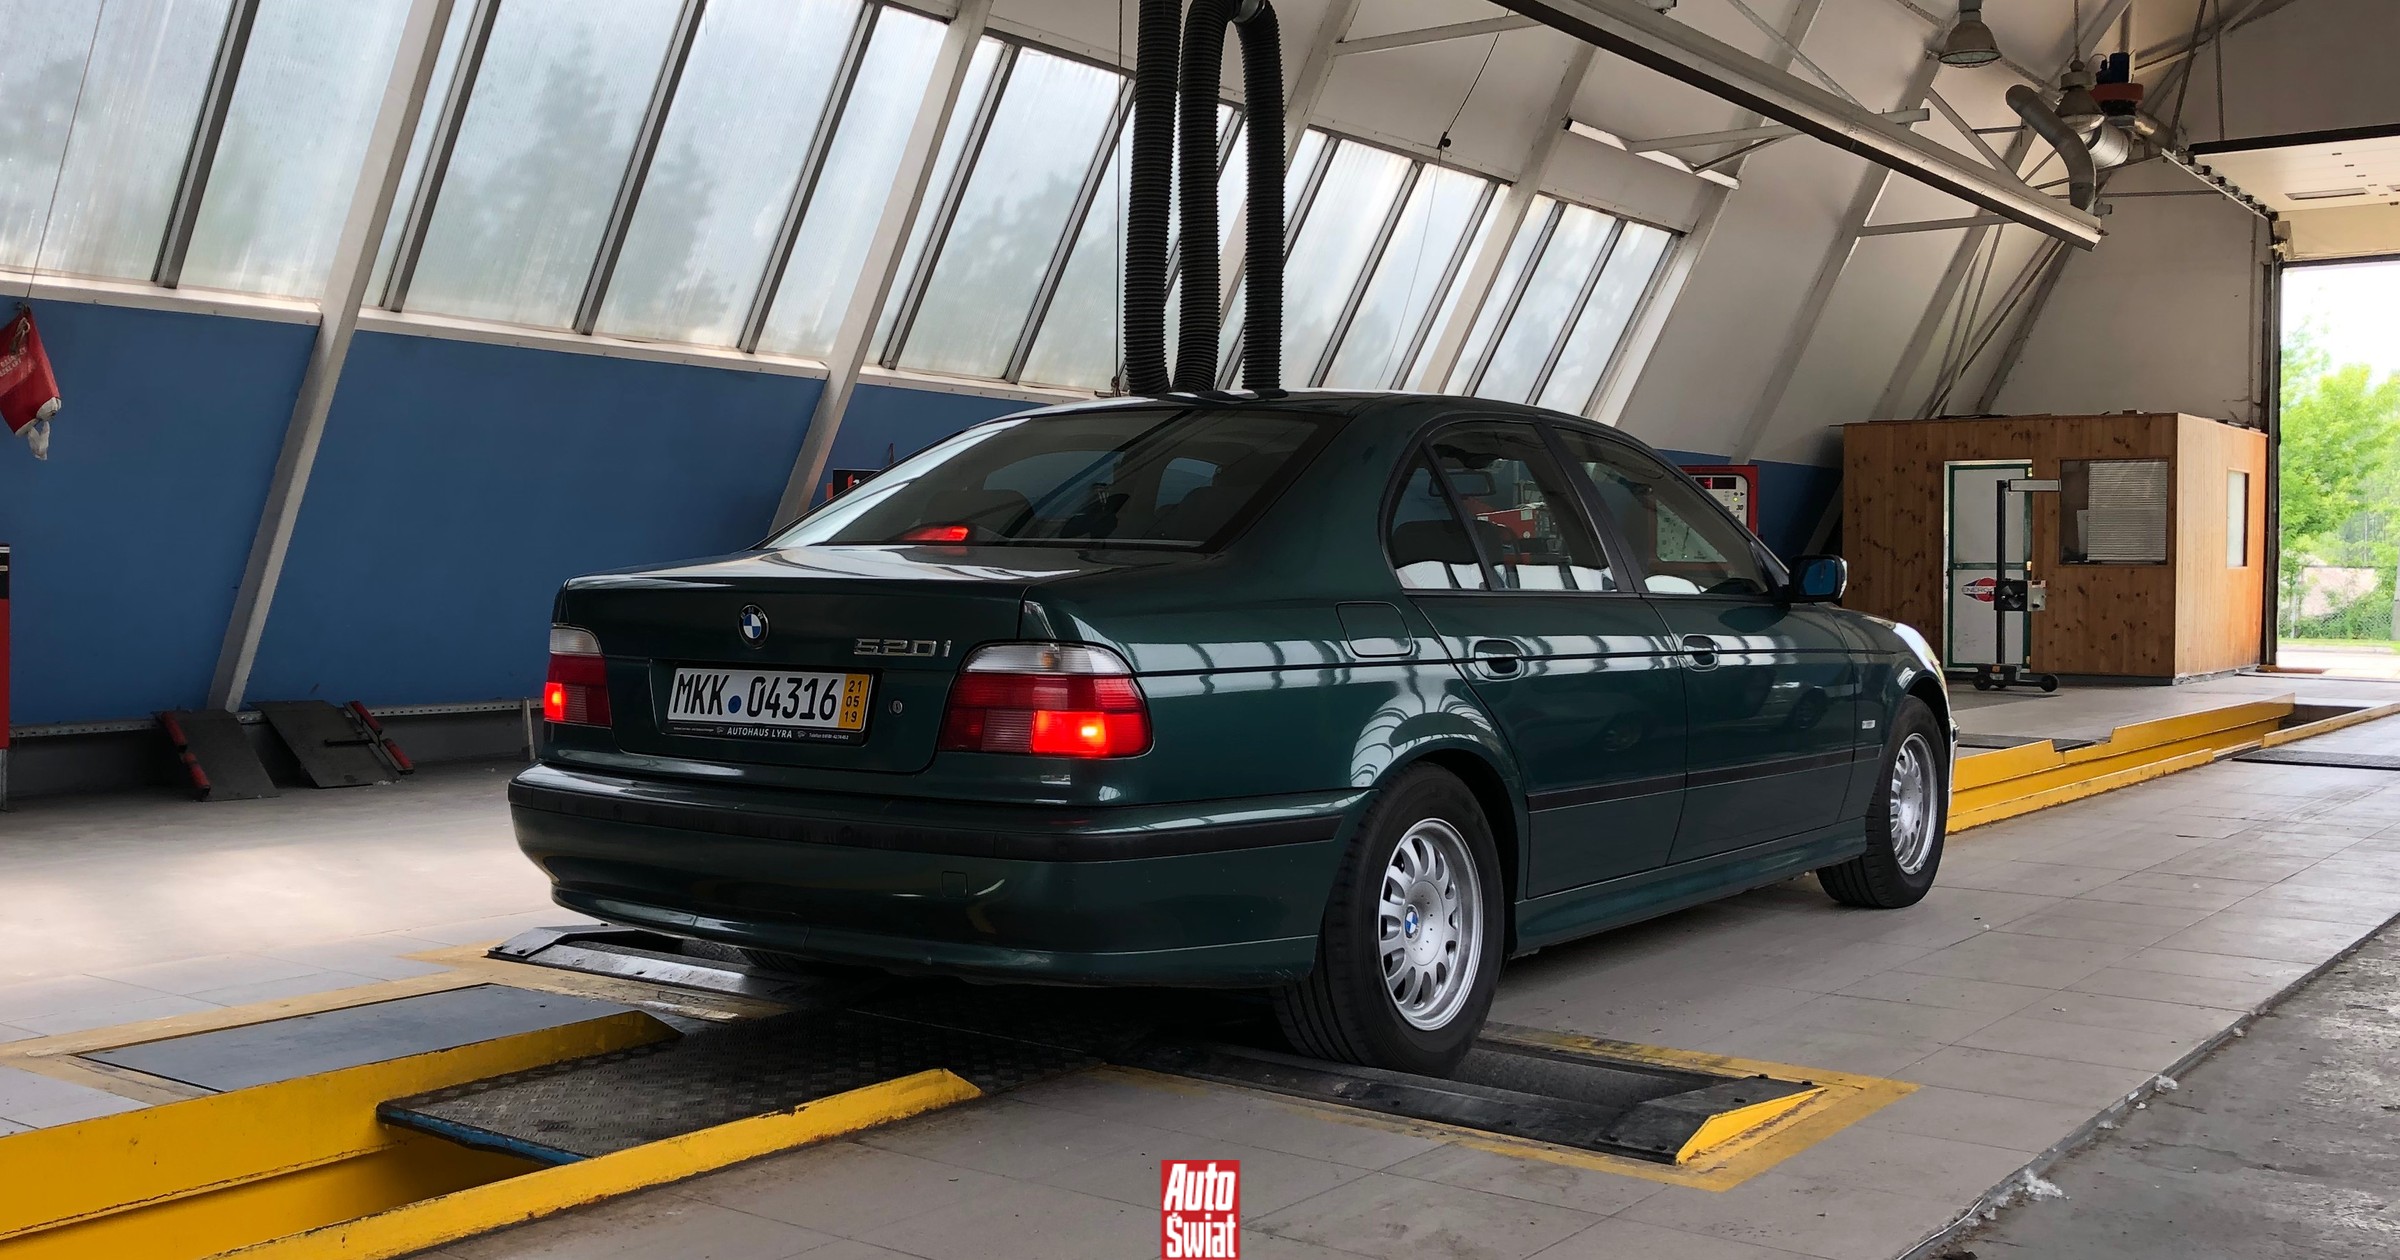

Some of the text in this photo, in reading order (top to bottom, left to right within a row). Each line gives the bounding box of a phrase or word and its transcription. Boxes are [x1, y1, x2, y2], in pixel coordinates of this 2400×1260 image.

[854, 638, 952, 657] 520i
[848, 680, 863, 693] 21
[673, 673, 838, 721] MKK 04316
[845, 695, 860, 708] 05
[844, 710, 858, 723] 19
[727, 726, 770, 737] AUTOHAUS
[771, 728, 793, 739] LYRA
